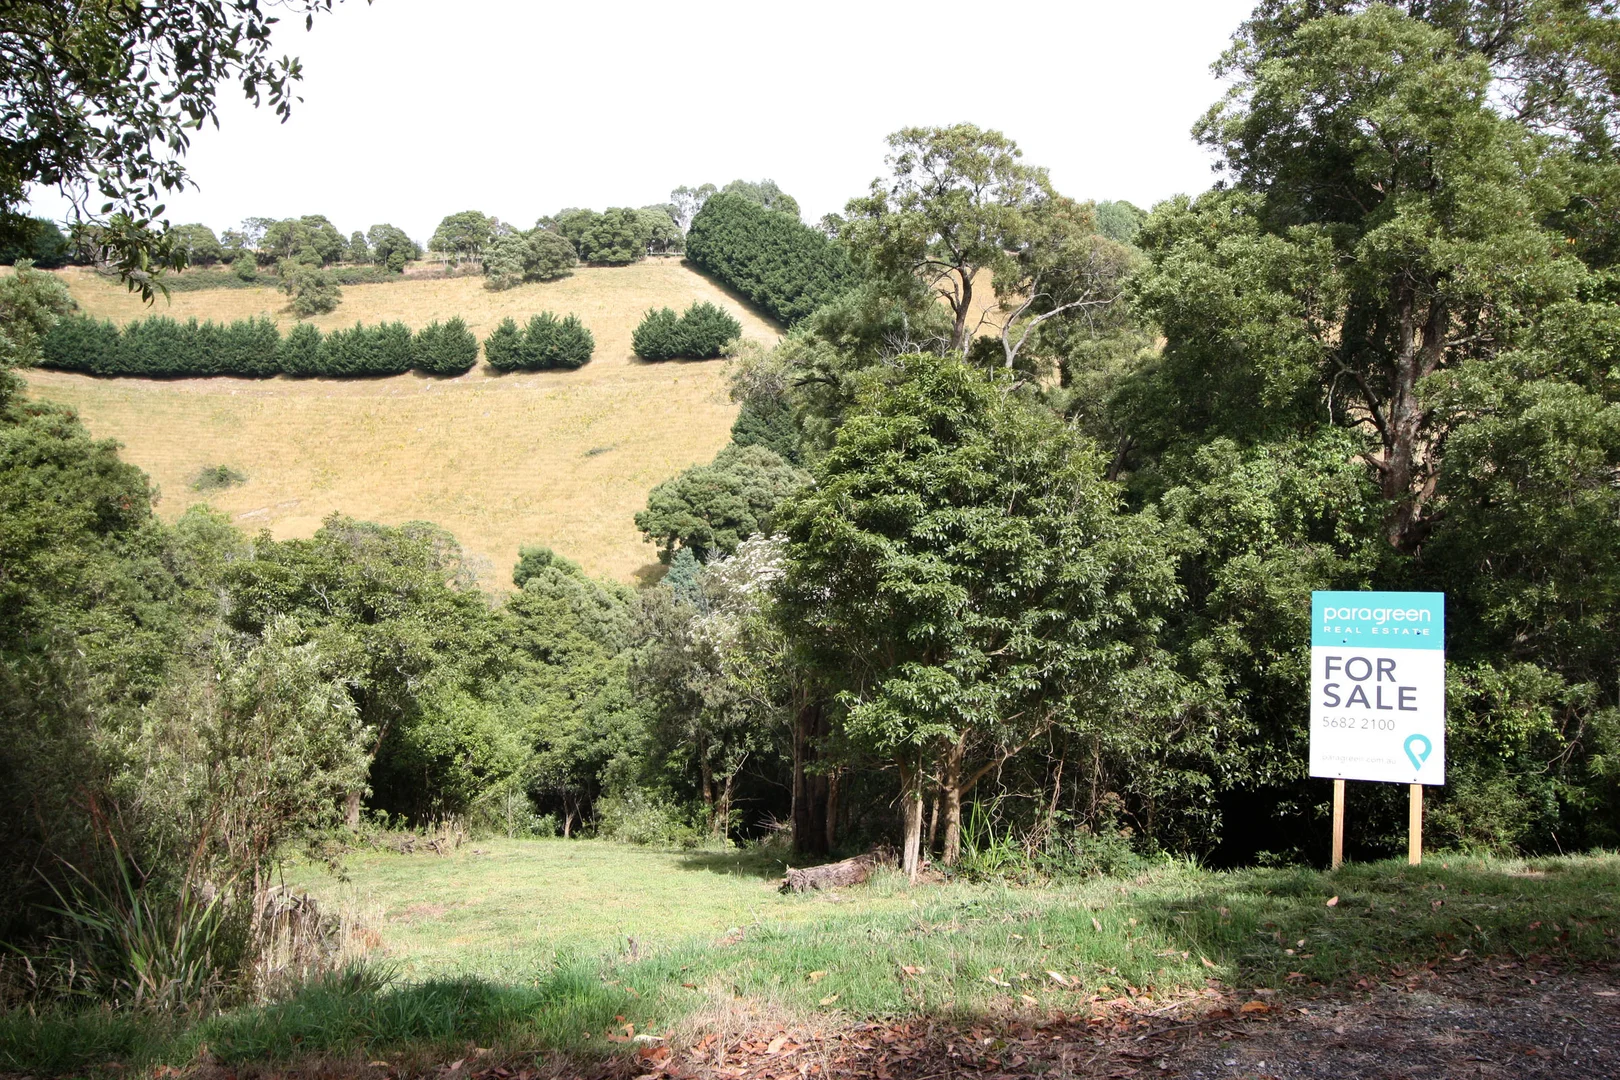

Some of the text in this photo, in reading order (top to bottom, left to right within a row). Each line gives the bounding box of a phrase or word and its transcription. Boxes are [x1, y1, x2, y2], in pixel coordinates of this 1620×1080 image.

[1324, 607, 1431, 625] paragreen
[1323, 626, 1430, 636] REAL ESTATE
[1325, 656, 1396, 682] FOR
[1323, 683, 1418, 711] SALE
[1322, 716, 1396, 731] 5682 2100
